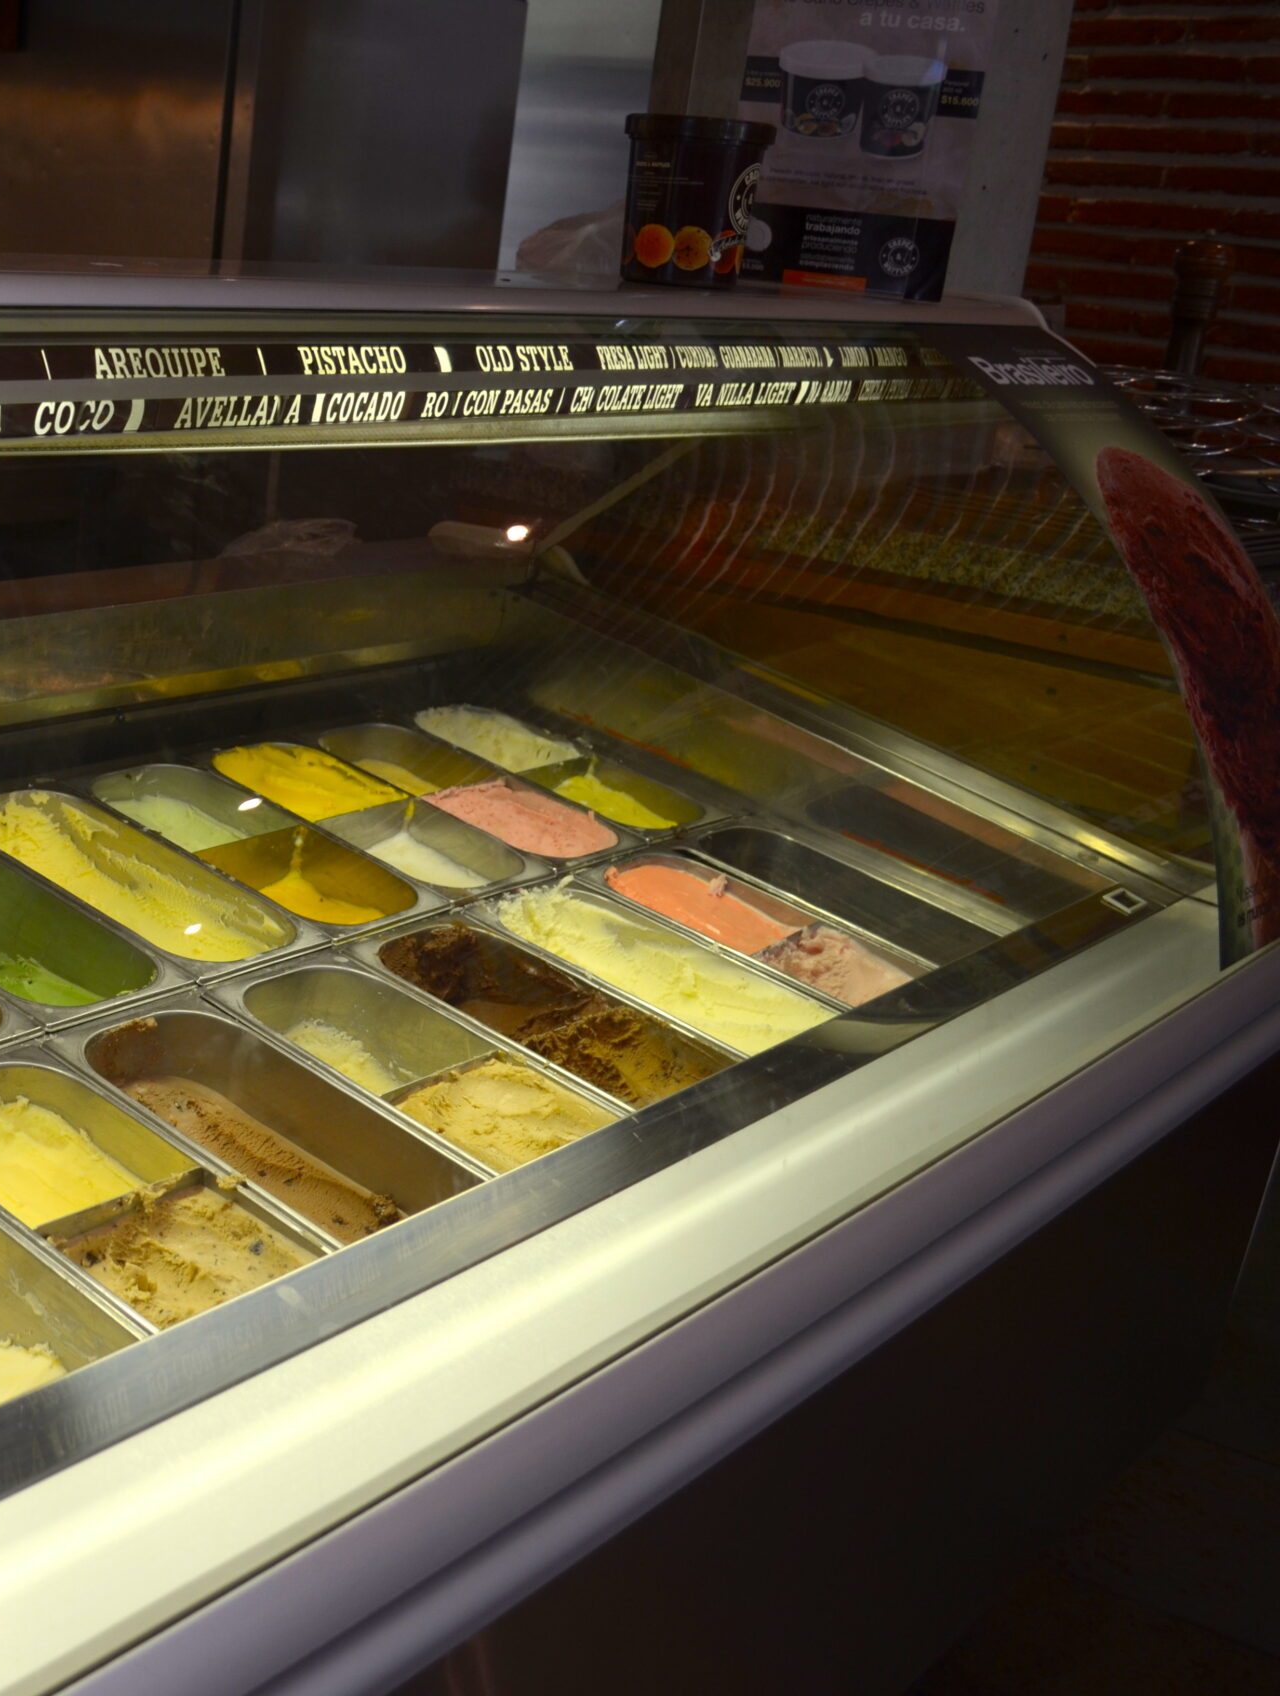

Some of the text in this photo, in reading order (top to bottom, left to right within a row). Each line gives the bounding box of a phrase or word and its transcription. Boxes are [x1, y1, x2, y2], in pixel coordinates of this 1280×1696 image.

[859, 10, 966, 32] a tu casa.
[804, 221, 861, 236] trabajando
[93, 347, 226, 380] AREQUIPE
[297, 345, 407, 375] PISTACHO
[475, 345, 574, 373] OLD STYLE
[595, 345, 670, 371] FRESA LIGHT
[966, 355, 1096, 387] Brasileiro
[462, 389, 502, 417] CON
[500, 388, 554, 415] PASAS
[641, 383, 685, 410] LIGHT
[753, 381, 797, 405] LIGHT
[33, 399, 116, 437] COCO
